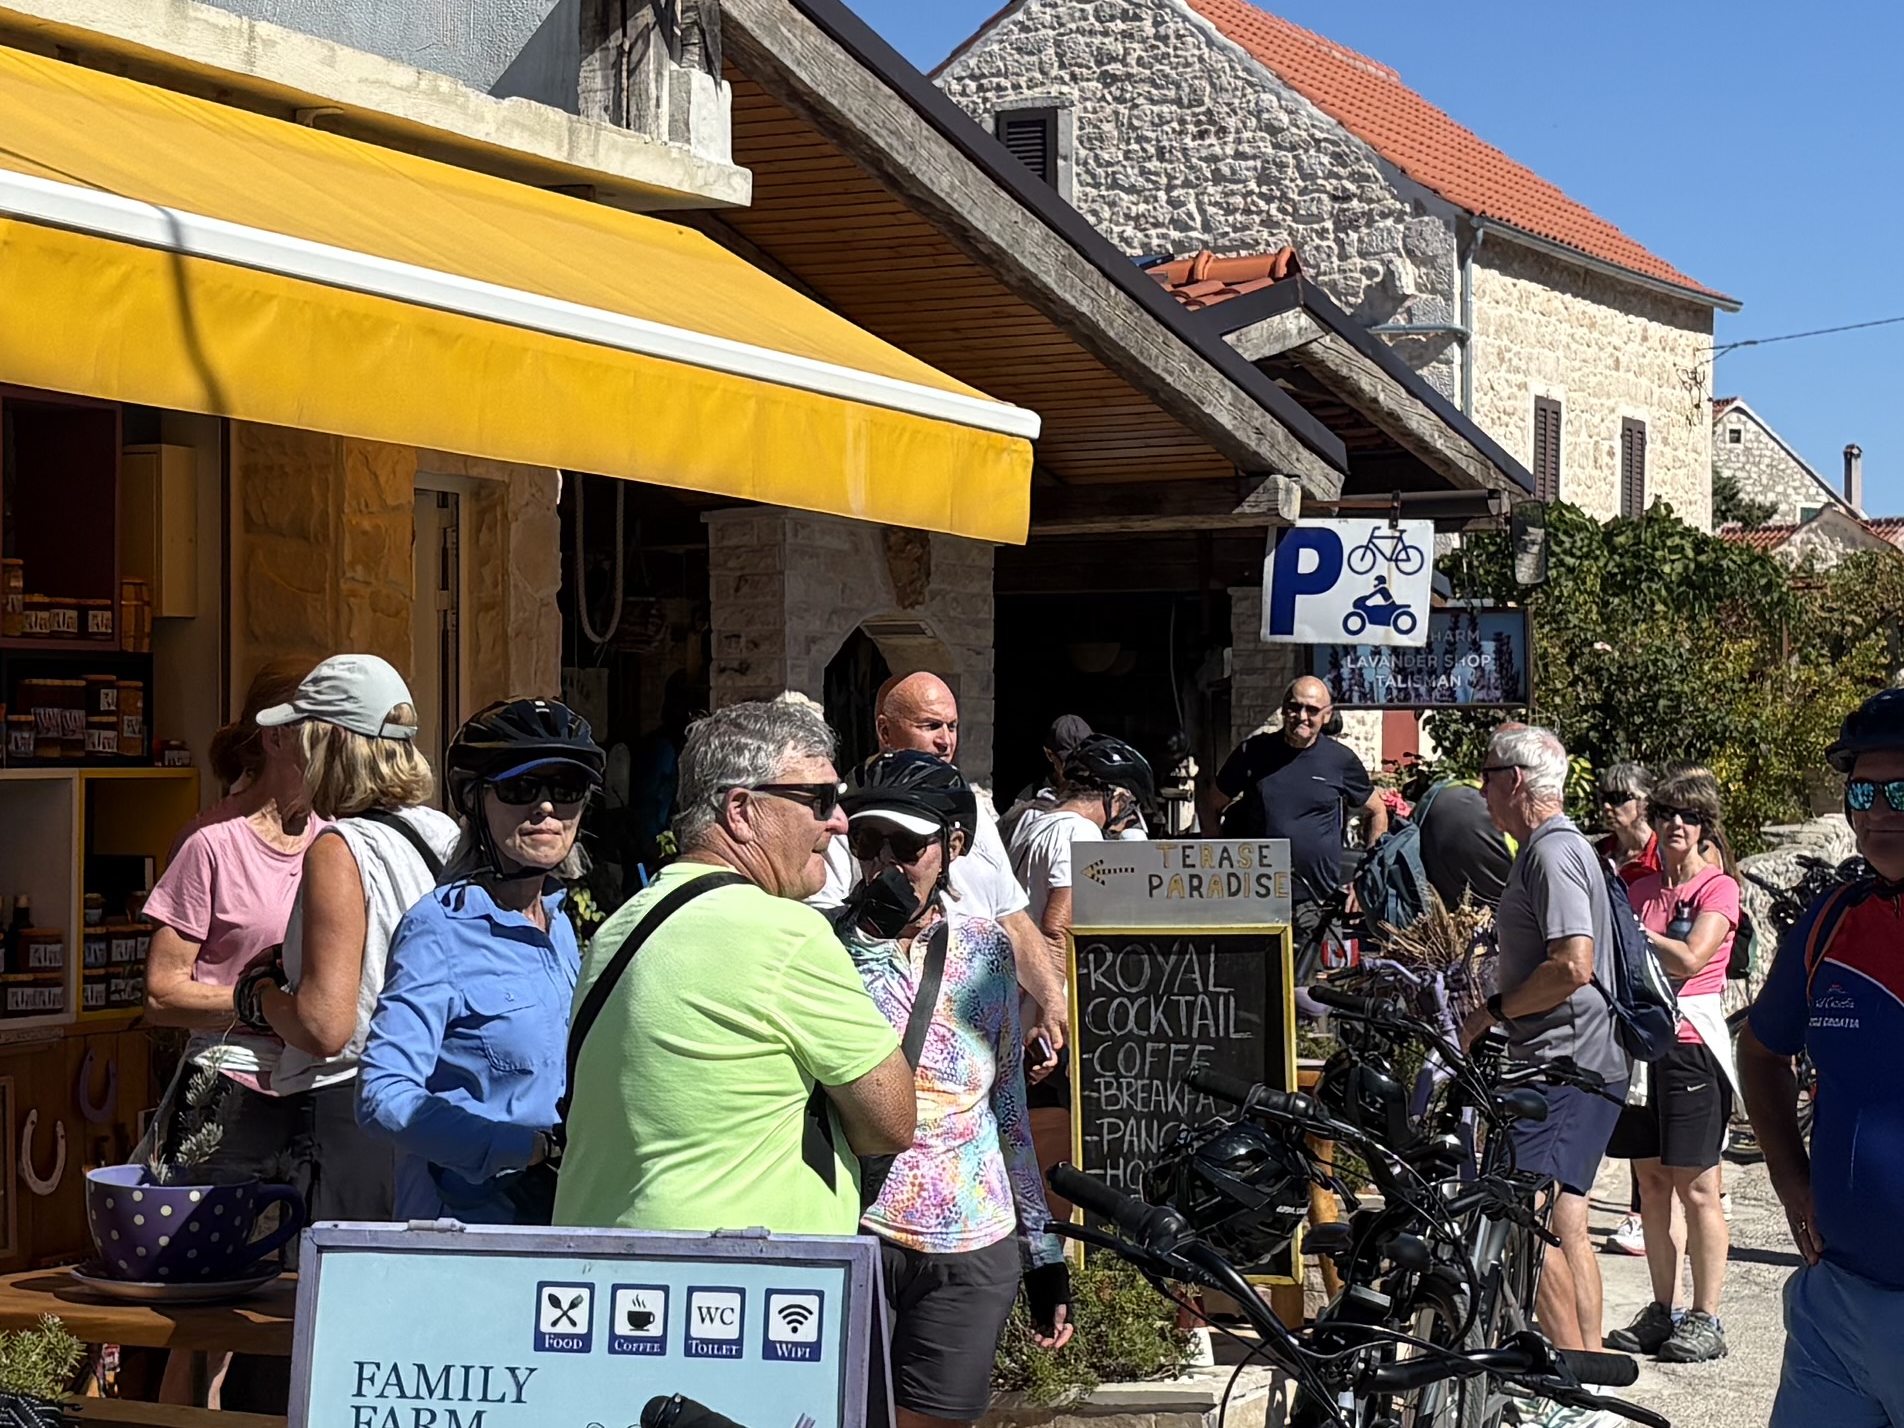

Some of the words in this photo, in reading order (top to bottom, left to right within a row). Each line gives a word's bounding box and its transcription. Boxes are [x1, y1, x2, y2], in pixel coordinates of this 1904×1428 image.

[1269, 526, 1344, 636] P
[1346, 654, 1438, 669] LAVANDER
[1444, 653, 1492, 668] SHOP
[1375, 674, 1462, 688] TALISMAN
[1156, 843, 1272, 869] TERASE
[1148, 872, 1290, 899] PARADISE
[1085, 994, 1255, 1038] COCKTAIL
[696, 1305, 735, 1326] WC
[351, 1360, 539, 1404] FAMILY
